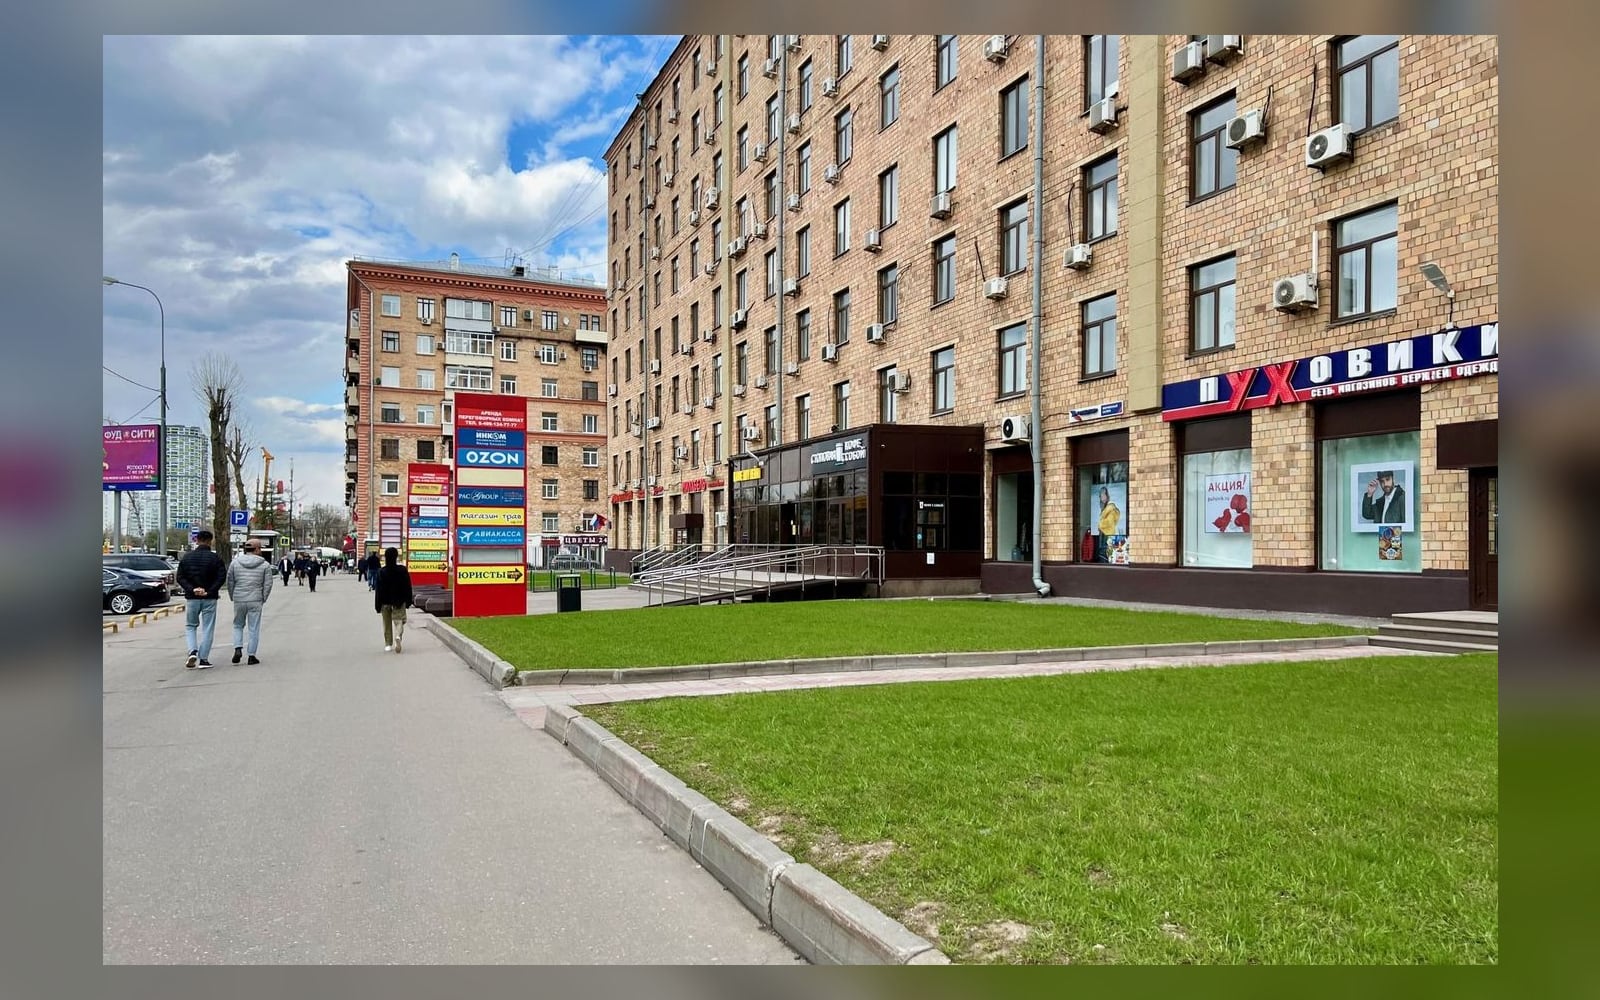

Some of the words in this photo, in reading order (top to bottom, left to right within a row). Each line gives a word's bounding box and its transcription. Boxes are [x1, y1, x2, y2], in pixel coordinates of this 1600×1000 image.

[1311, 386, 1334, 398] СЕТЬ
[1338, 376, 1396, 394] МАГАЗИНОВ
[104, 430, 122, 441] ФУД
[131, 429, 155, 439] СИТИ
[466, 451, 519, 465] OZON
[1208, 475, 1247, 493] АКЦИЯ!
[235, 513, 245, 524] P
[503, 513, 522, 522] трав
[458, 571, 506, 579] ЮРИСТЫ
